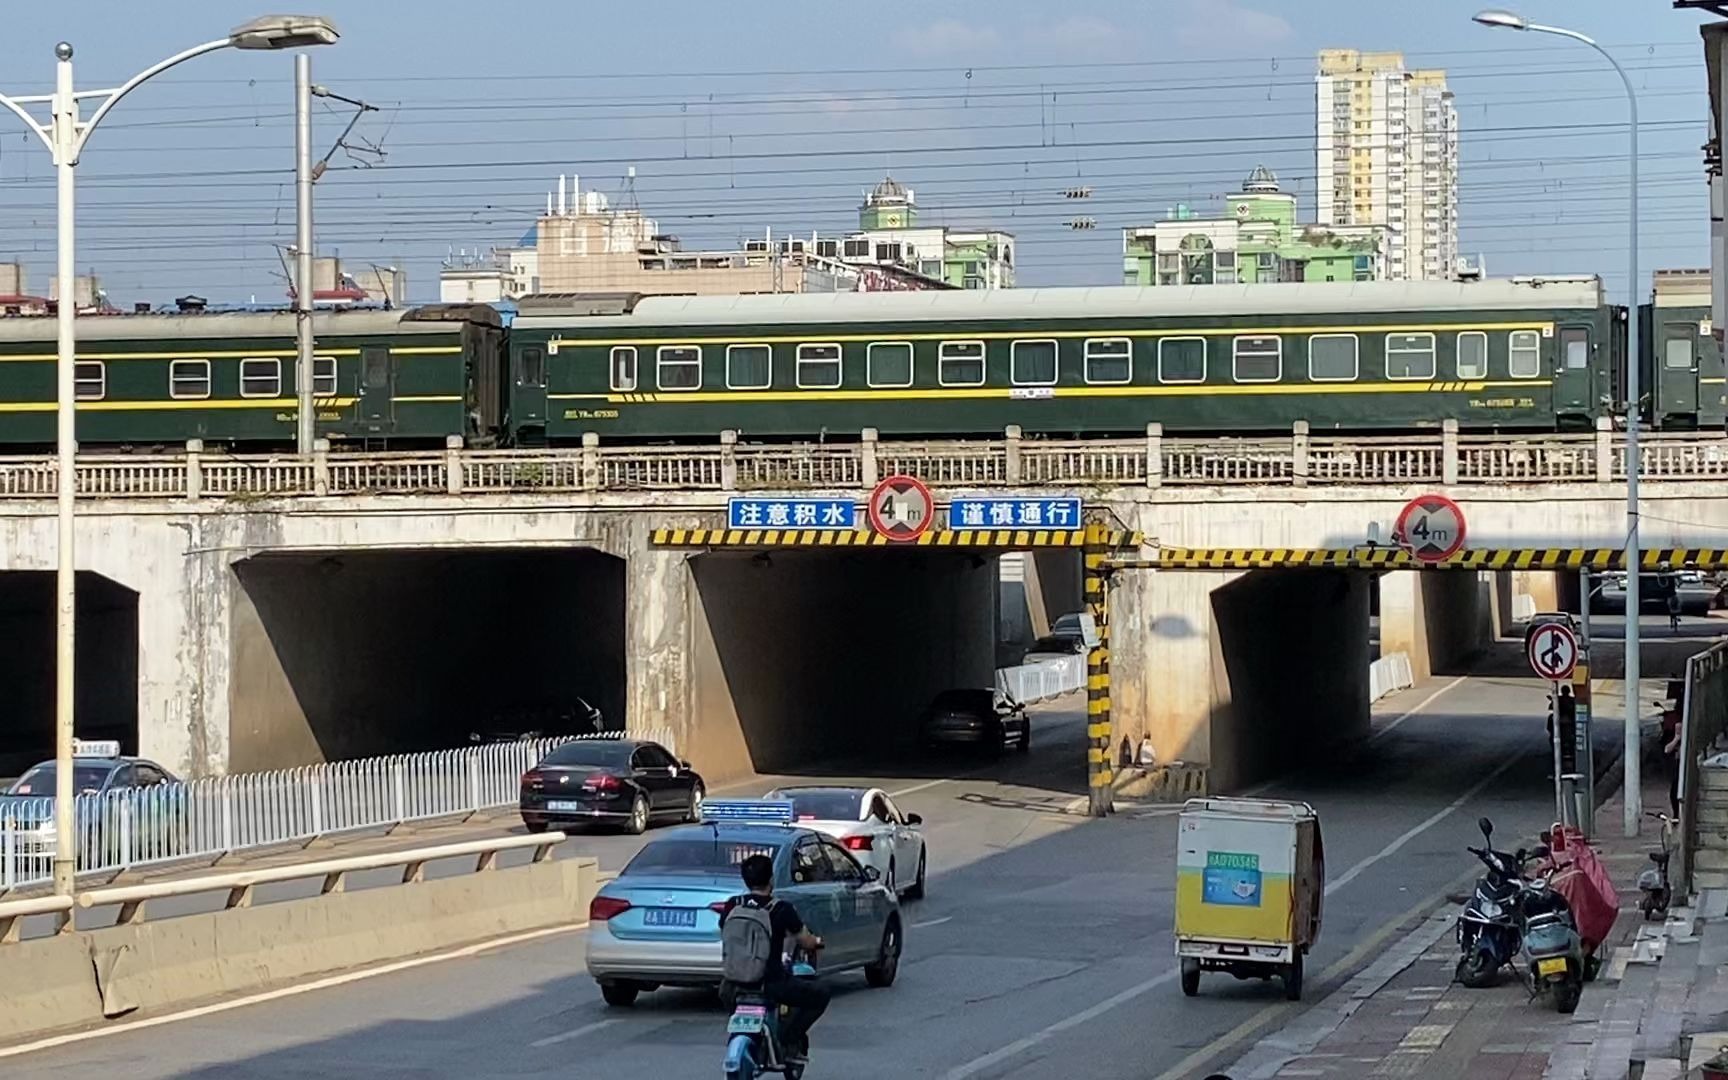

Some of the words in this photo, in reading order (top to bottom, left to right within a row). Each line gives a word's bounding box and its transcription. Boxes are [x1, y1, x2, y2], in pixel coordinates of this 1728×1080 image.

[739, 503, 845, 525] 注意积水
[961, 501, 1071, 525] 谨慎通行
